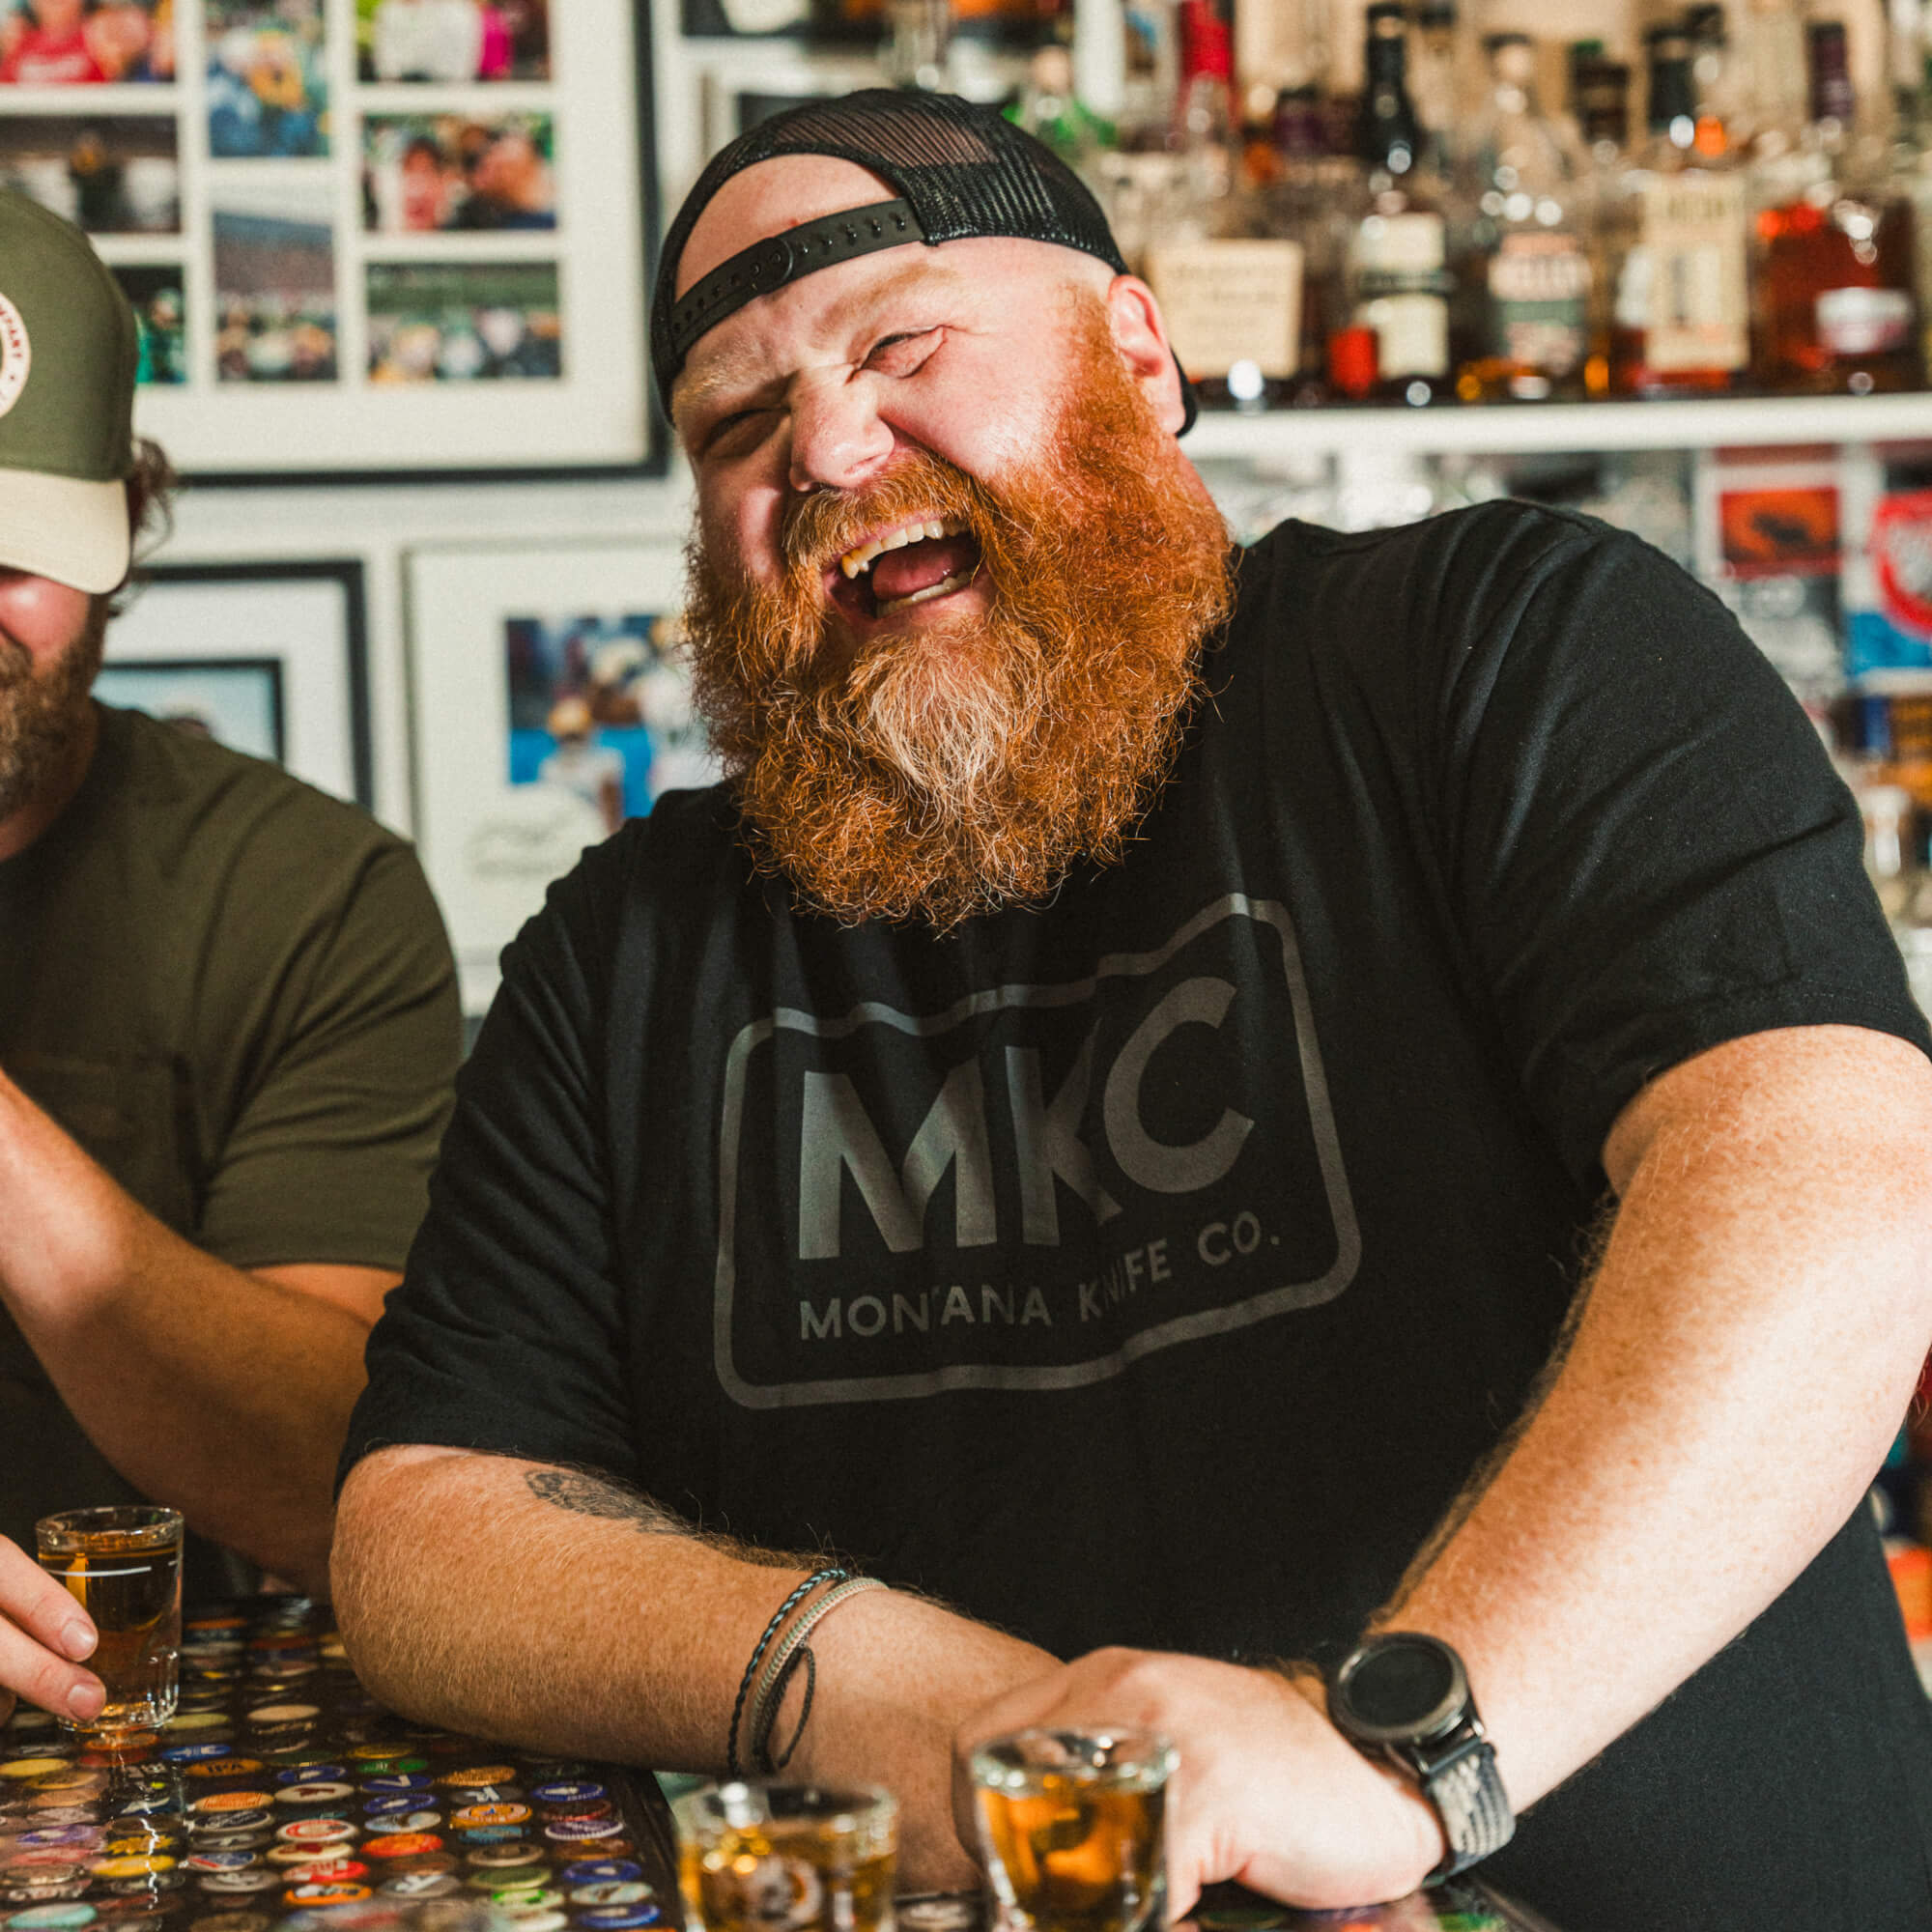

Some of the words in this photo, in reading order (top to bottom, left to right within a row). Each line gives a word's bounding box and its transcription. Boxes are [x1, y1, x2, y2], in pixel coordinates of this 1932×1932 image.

[799, 977, 1255, 1260] MKC
[800, 1285, 1052, 1341] MONANA
[1197, 1211, 1280, 1266] CO.
